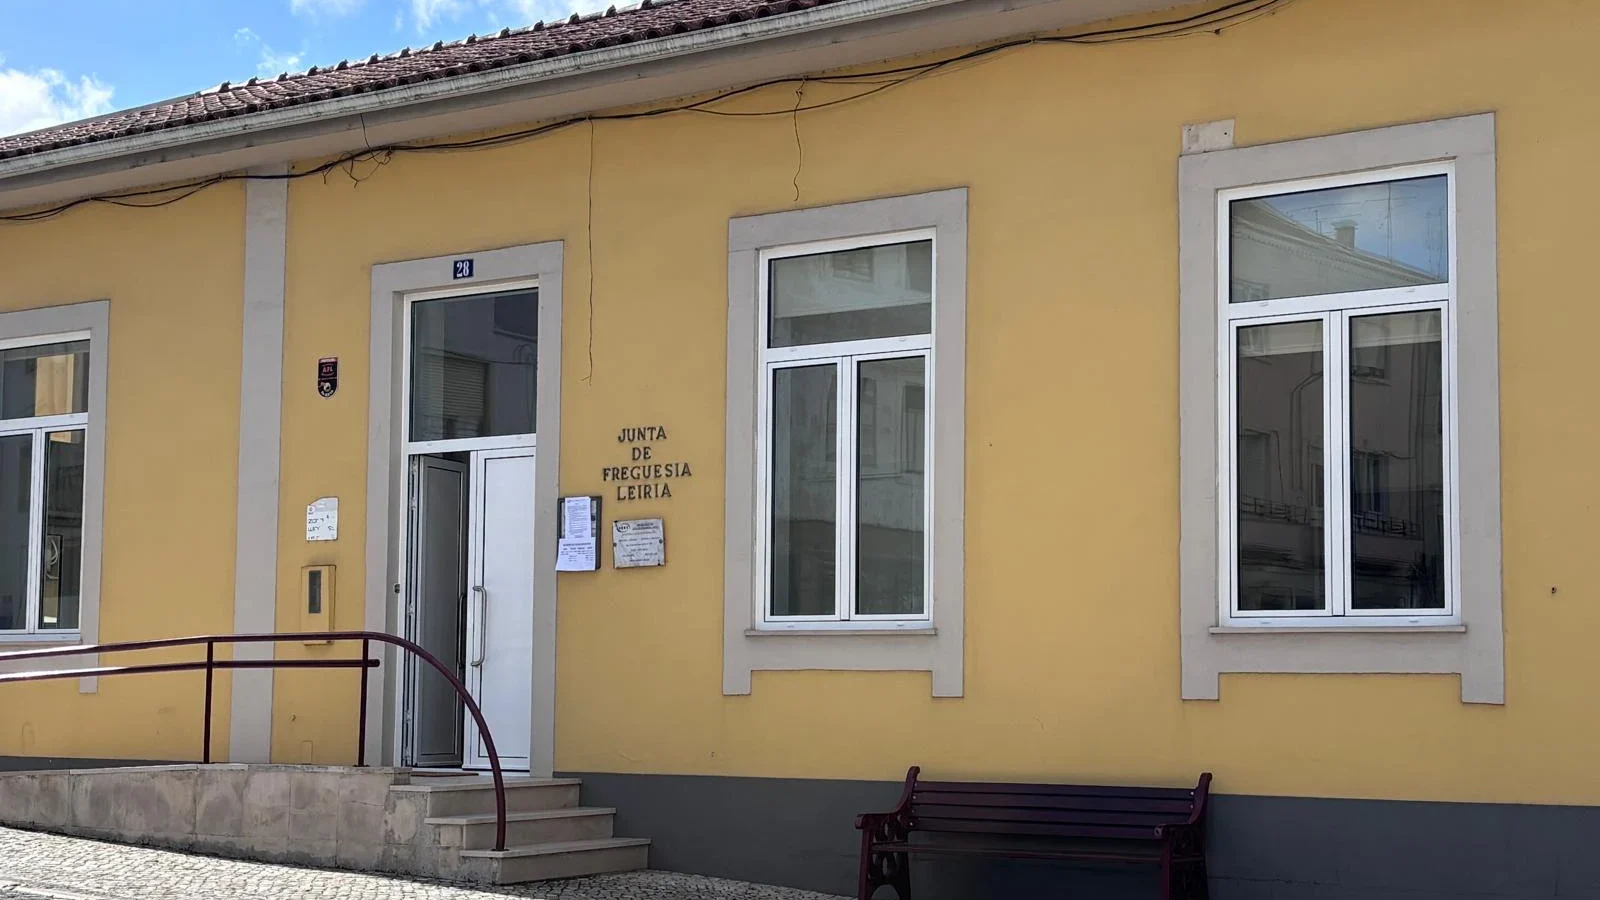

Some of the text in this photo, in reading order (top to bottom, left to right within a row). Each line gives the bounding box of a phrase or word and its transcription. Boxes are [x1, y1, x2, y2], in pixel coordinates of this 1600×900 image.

[456, 261, 469, 277] 28
[618, 426, 667, 443] JUNTA
[632, 447, 652, 461] DE
[603, 462, 692, 481] FREGUESIA
[617, 483, 672, 501] LEIRIA
